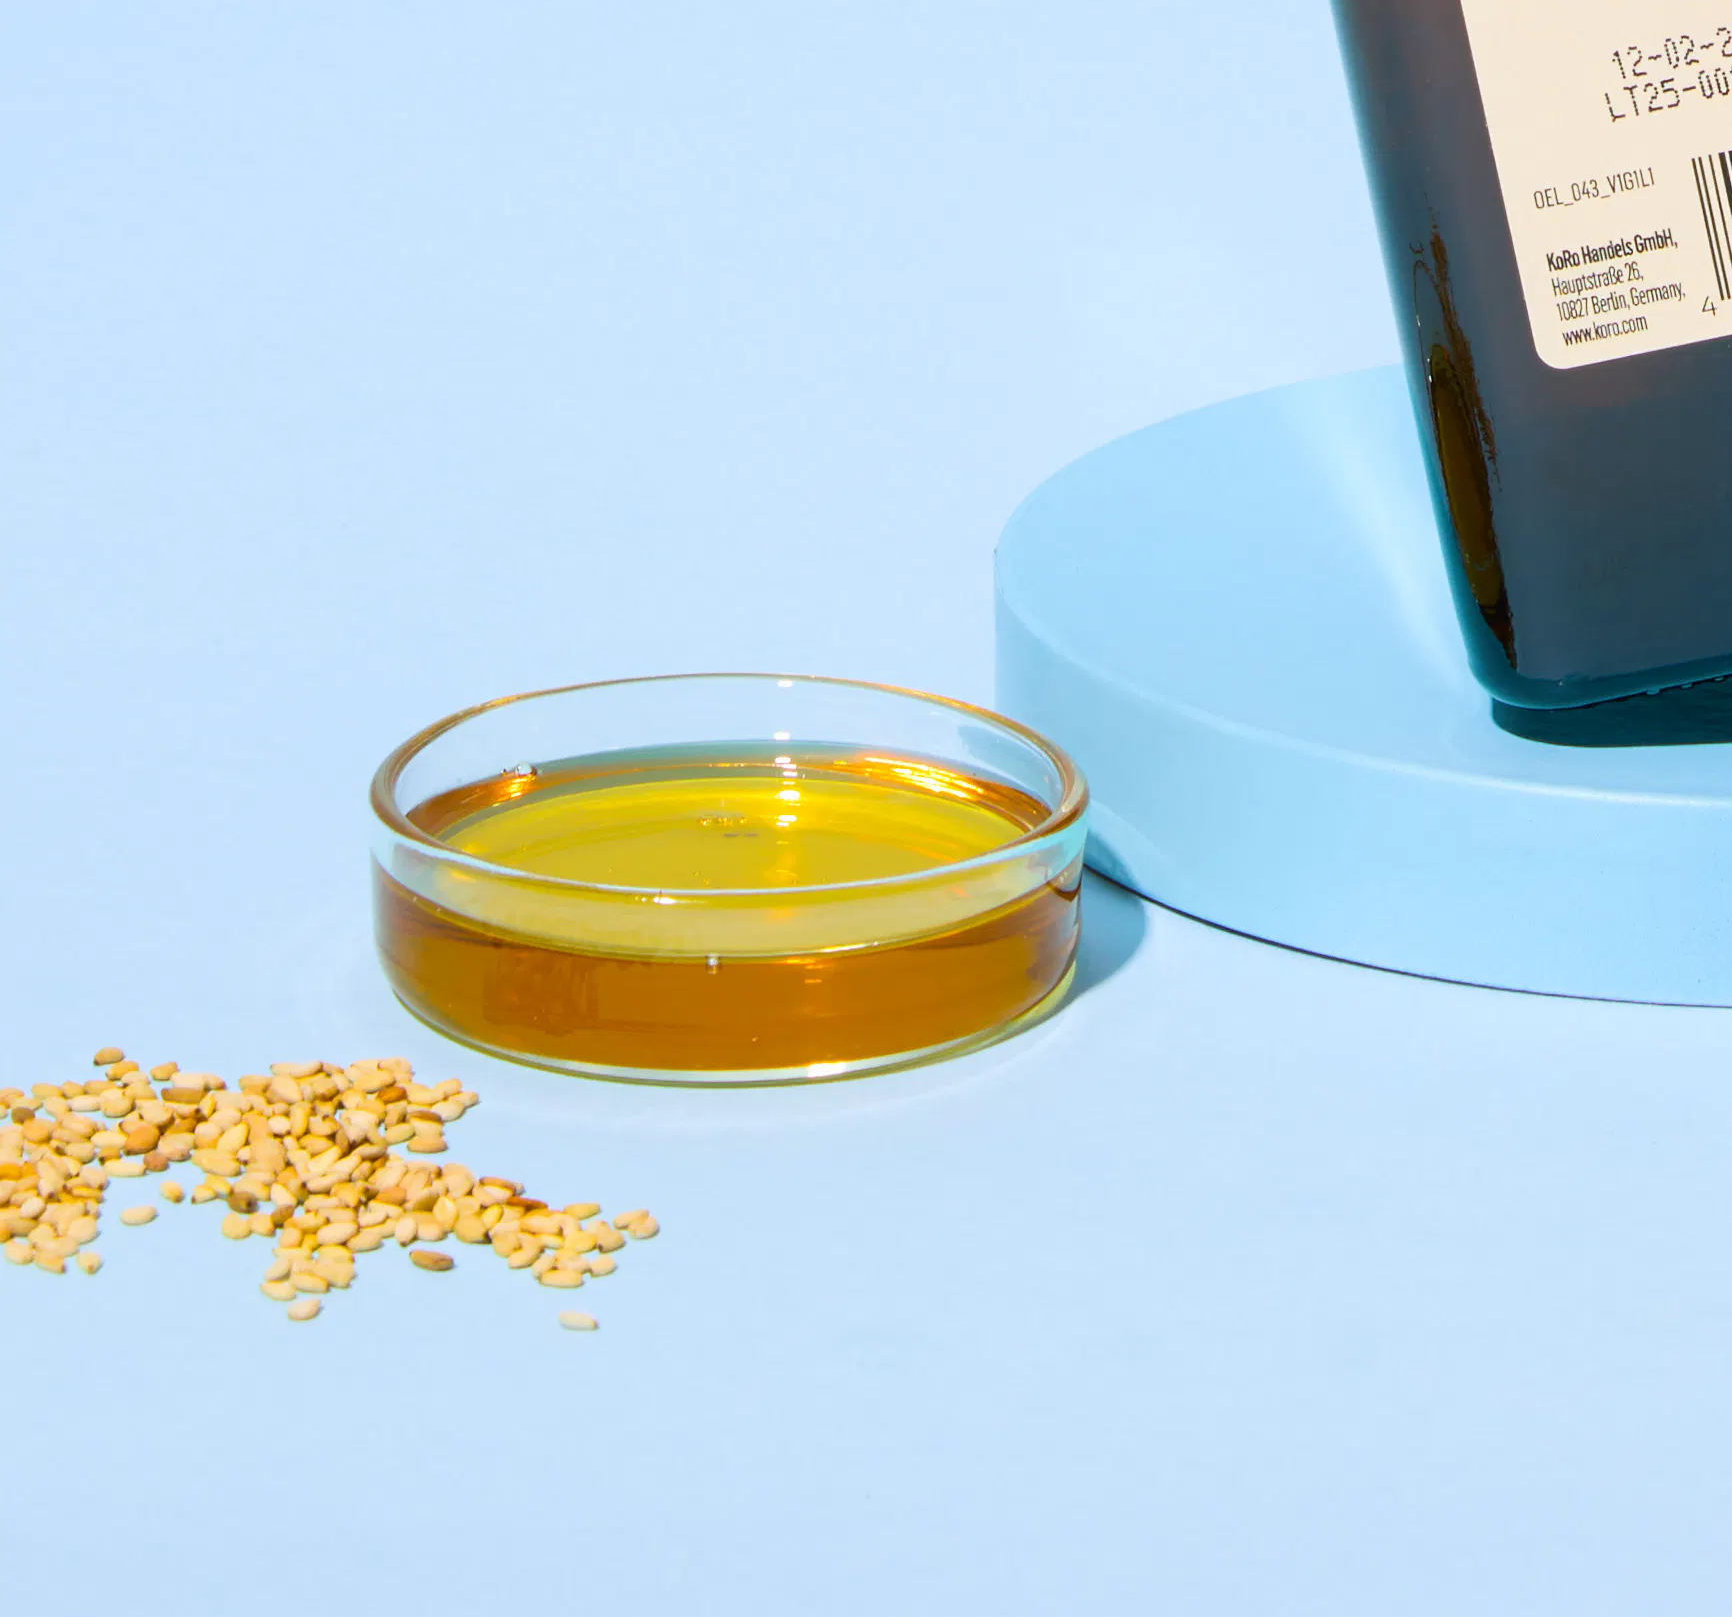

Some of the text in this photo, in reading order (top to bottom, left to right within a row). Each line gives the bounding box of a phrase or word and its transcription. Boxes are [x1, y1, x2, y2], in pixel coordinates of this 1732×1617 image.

[1545, 226, 1679, 273] KoRo Handels GmbH,
[1550, 259, 1644, 298] Hauptstraße 26,
[1555, 281, 1686, 322] 10827 Berlin, Germany,
[1700, 294, 1718, 317] 4
[1560, 315, 1649, 347] www.koro.com
